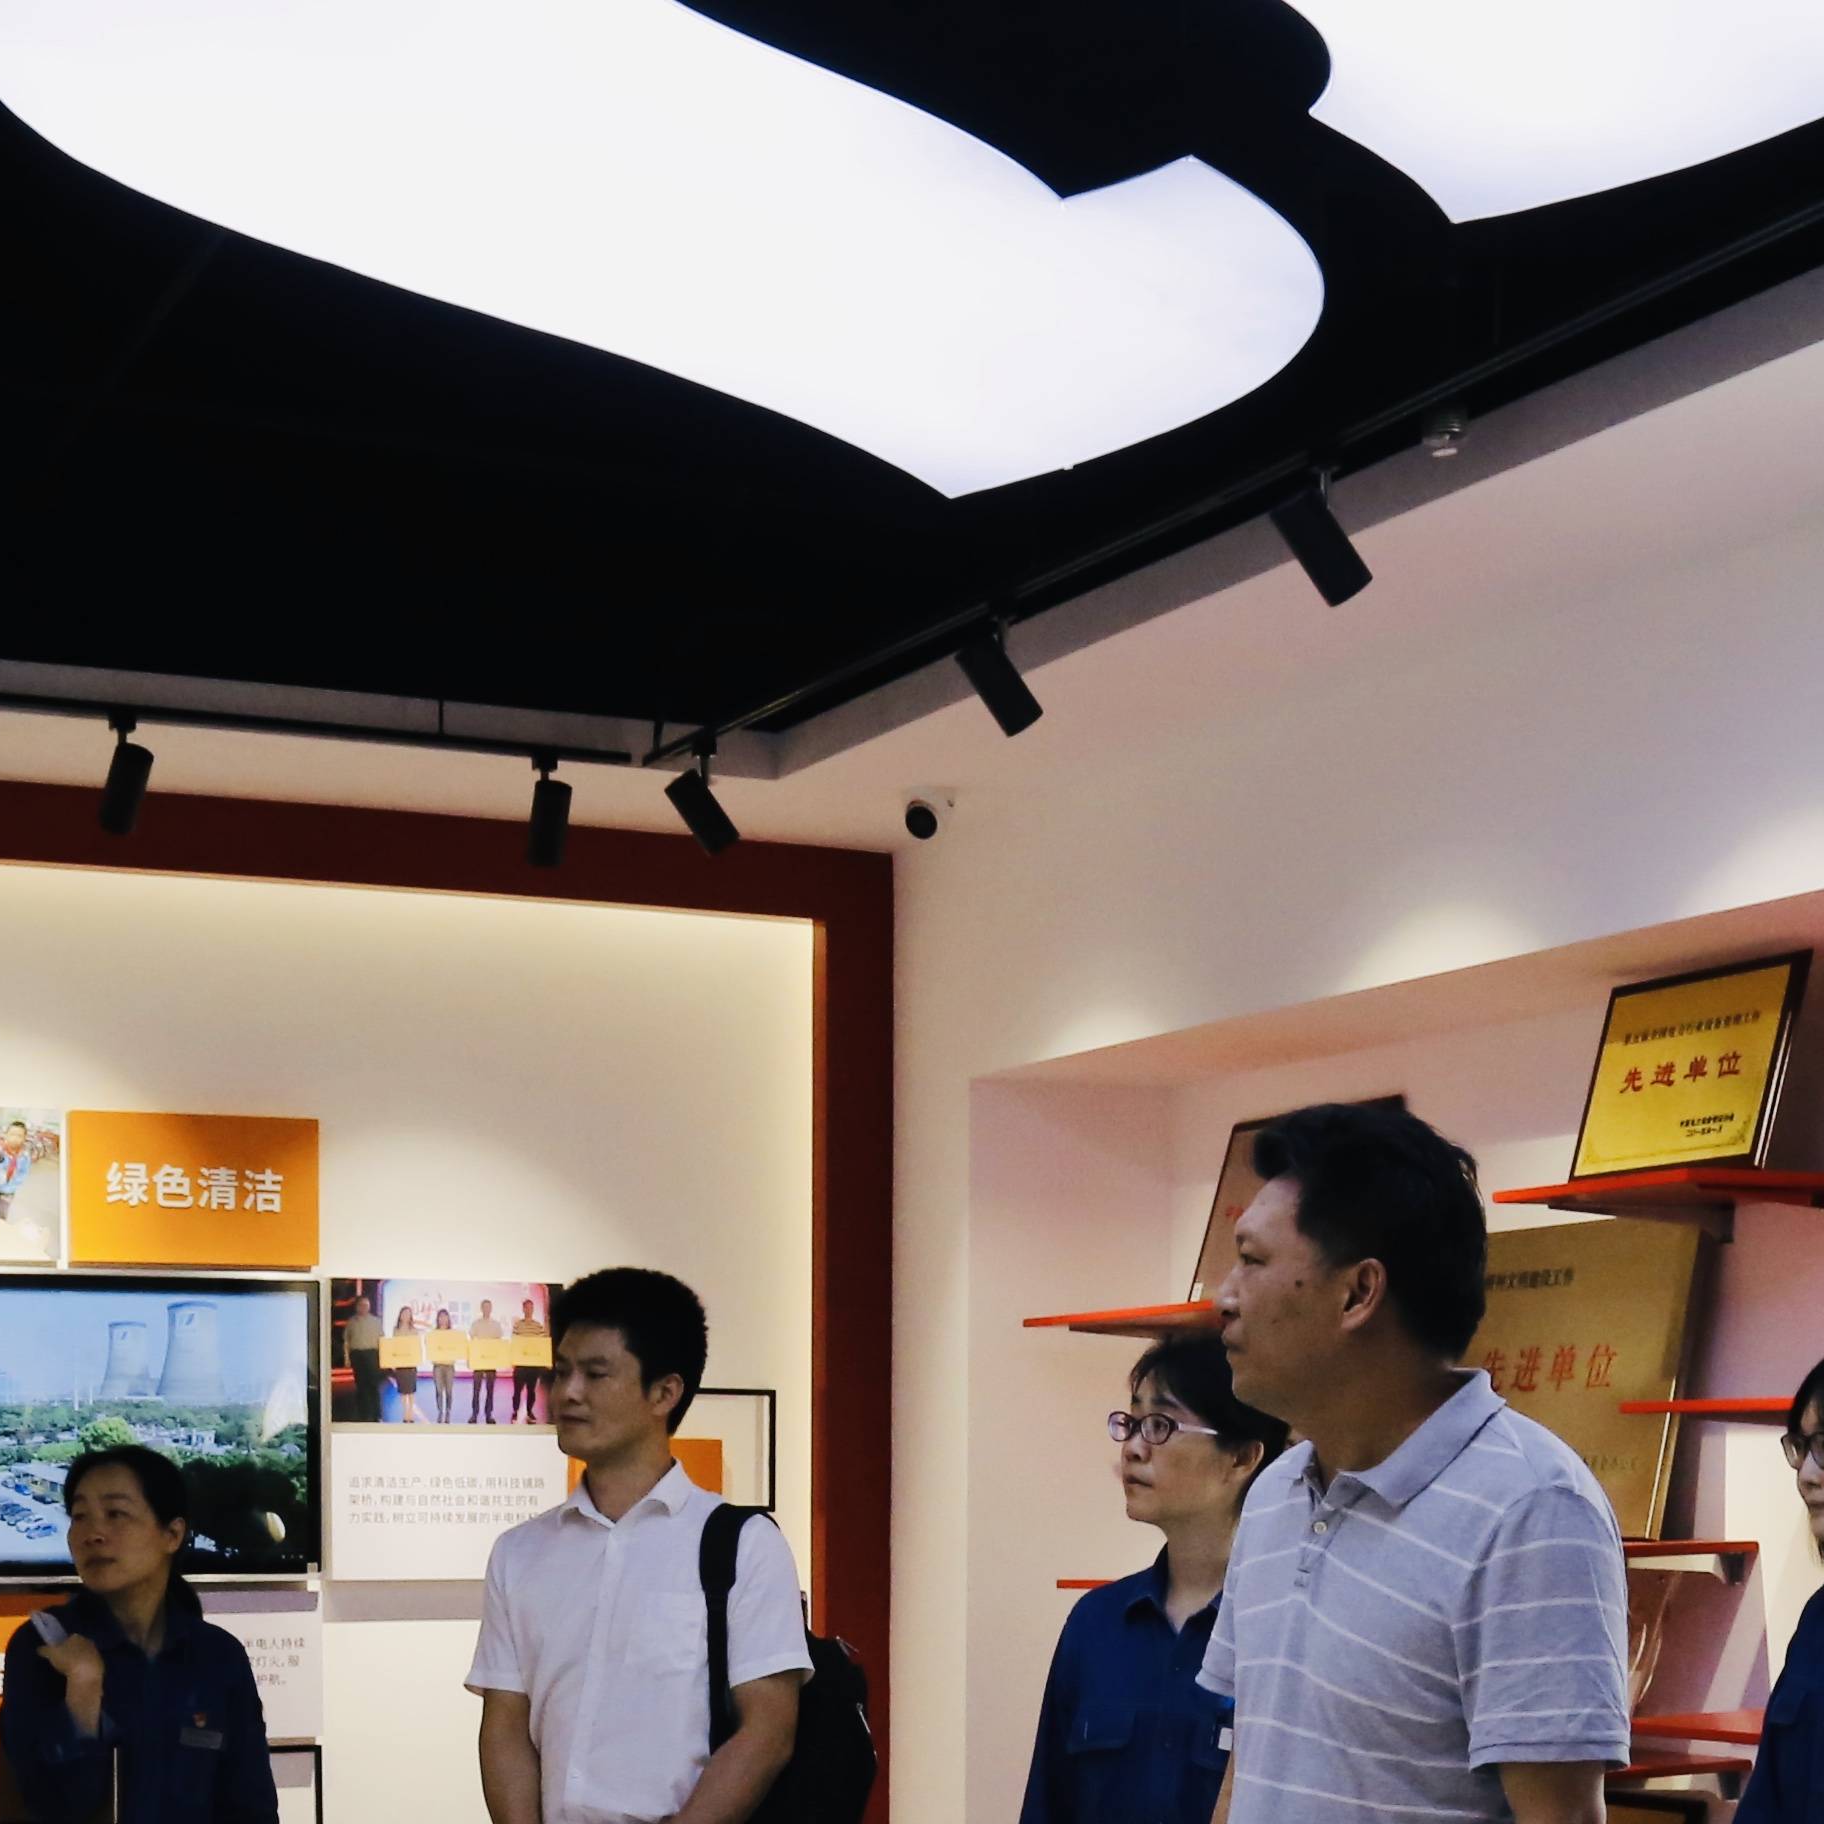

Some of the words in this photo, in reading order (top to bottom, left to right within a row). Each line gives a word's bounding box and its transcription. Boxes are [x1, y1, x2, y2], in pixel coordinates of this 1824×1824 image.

[1619, 1051, 1742, 1094] 先进单位
[106, 1160, 284, 1213] 绿色清洁
[1483, 1344, 1616, 1393] 先进单位
